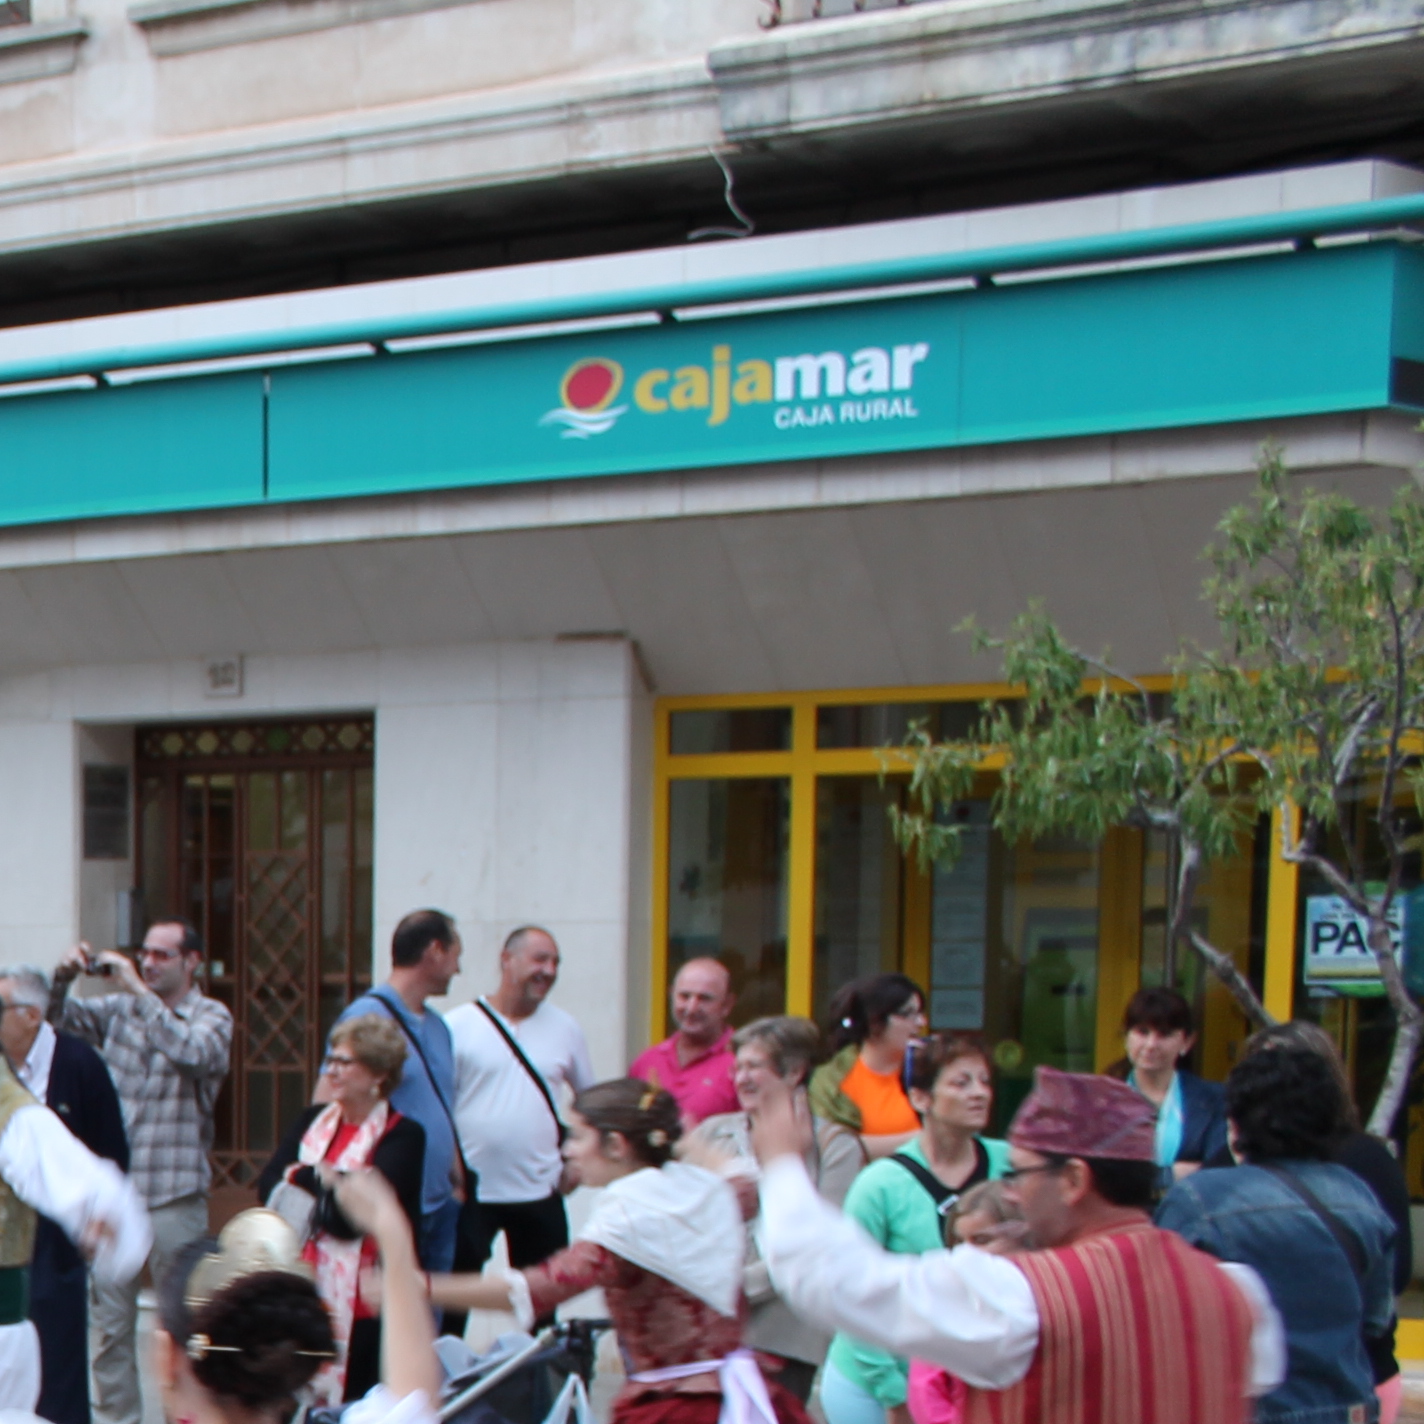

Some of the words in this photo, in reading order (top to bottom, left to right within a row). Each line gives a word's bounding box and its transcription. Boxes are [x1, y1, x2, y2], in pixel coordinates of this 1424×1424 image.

[633, 341, 930, 427] cajamar
[774, 406, 835, 430] CAJA
[840, 397, 918, 423] RURAL
